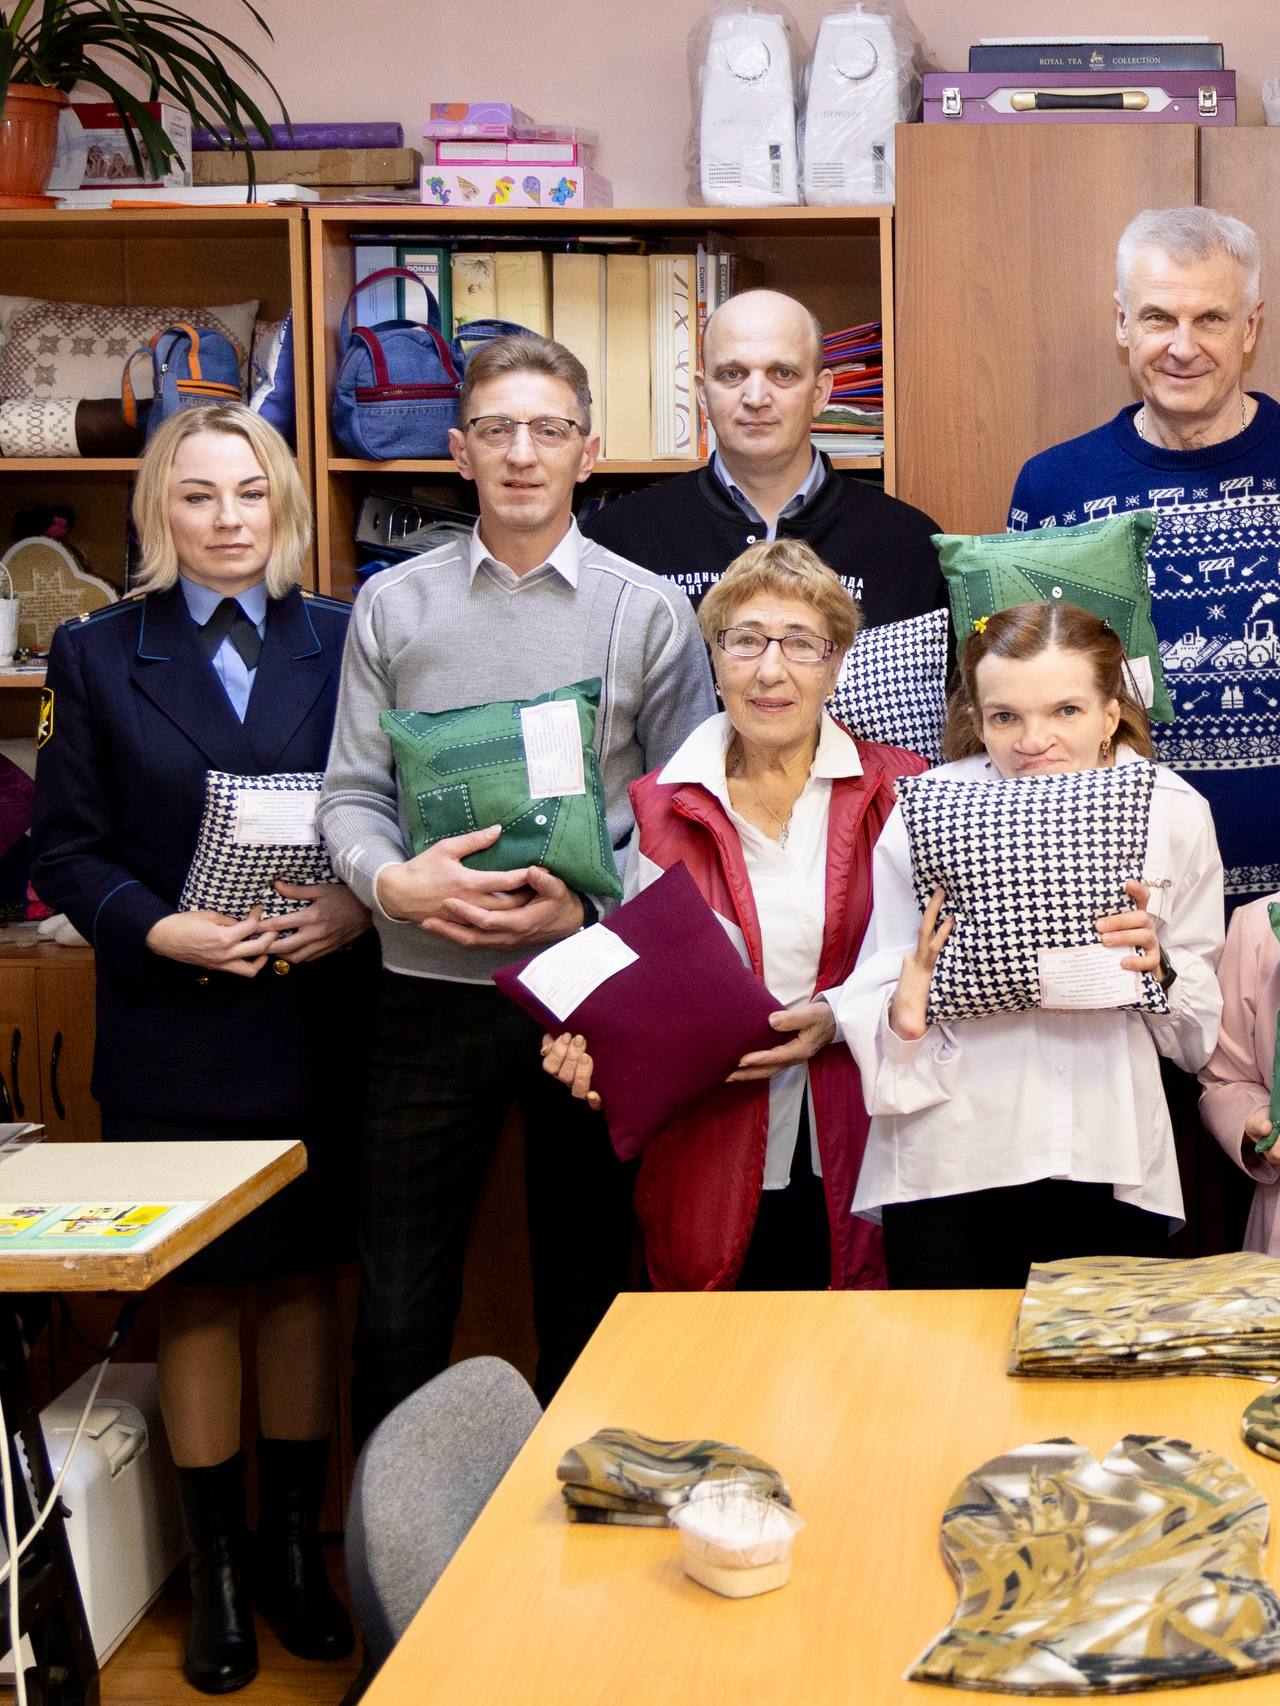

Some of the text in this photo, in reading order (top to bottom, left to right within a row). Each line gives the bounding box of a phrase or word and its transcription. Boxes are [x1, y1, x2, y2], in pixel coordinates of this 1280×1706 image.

[1039, 56, 1161, 66] ROYAL TEA COLLECTION
[406, 265, 437, 273] DONAU
